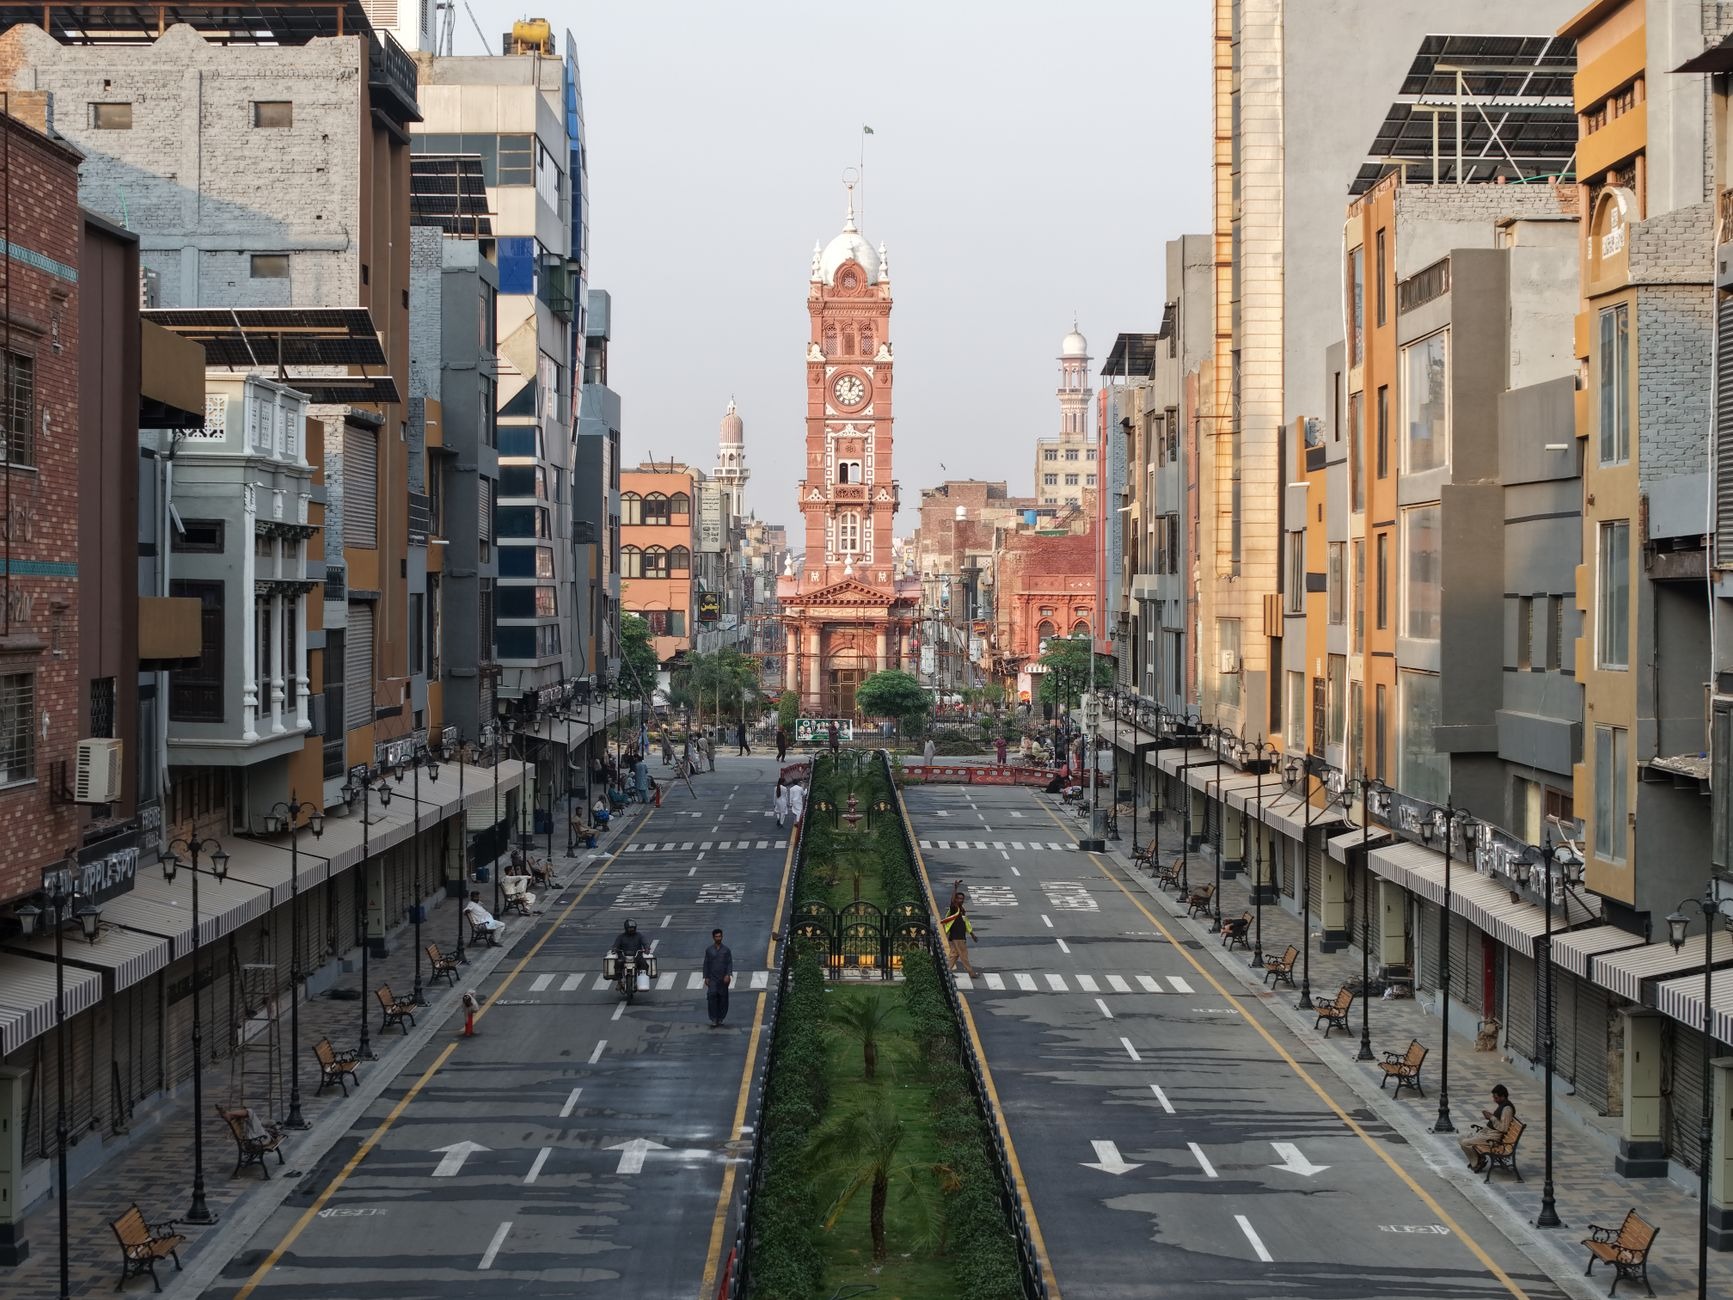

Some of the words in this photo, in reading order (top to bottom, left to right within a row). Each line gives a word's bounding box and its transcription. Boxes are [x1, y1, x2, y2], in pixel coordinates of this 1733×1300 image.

[82, 858, 113, 896] APPLE
[112, 848, 140, 884] SPOT
[695, 882, 747, 904] BAZAR
[966, 885, 1019, 906] BAZAR
[1039, 881, 1101, 912] KATCHERY
